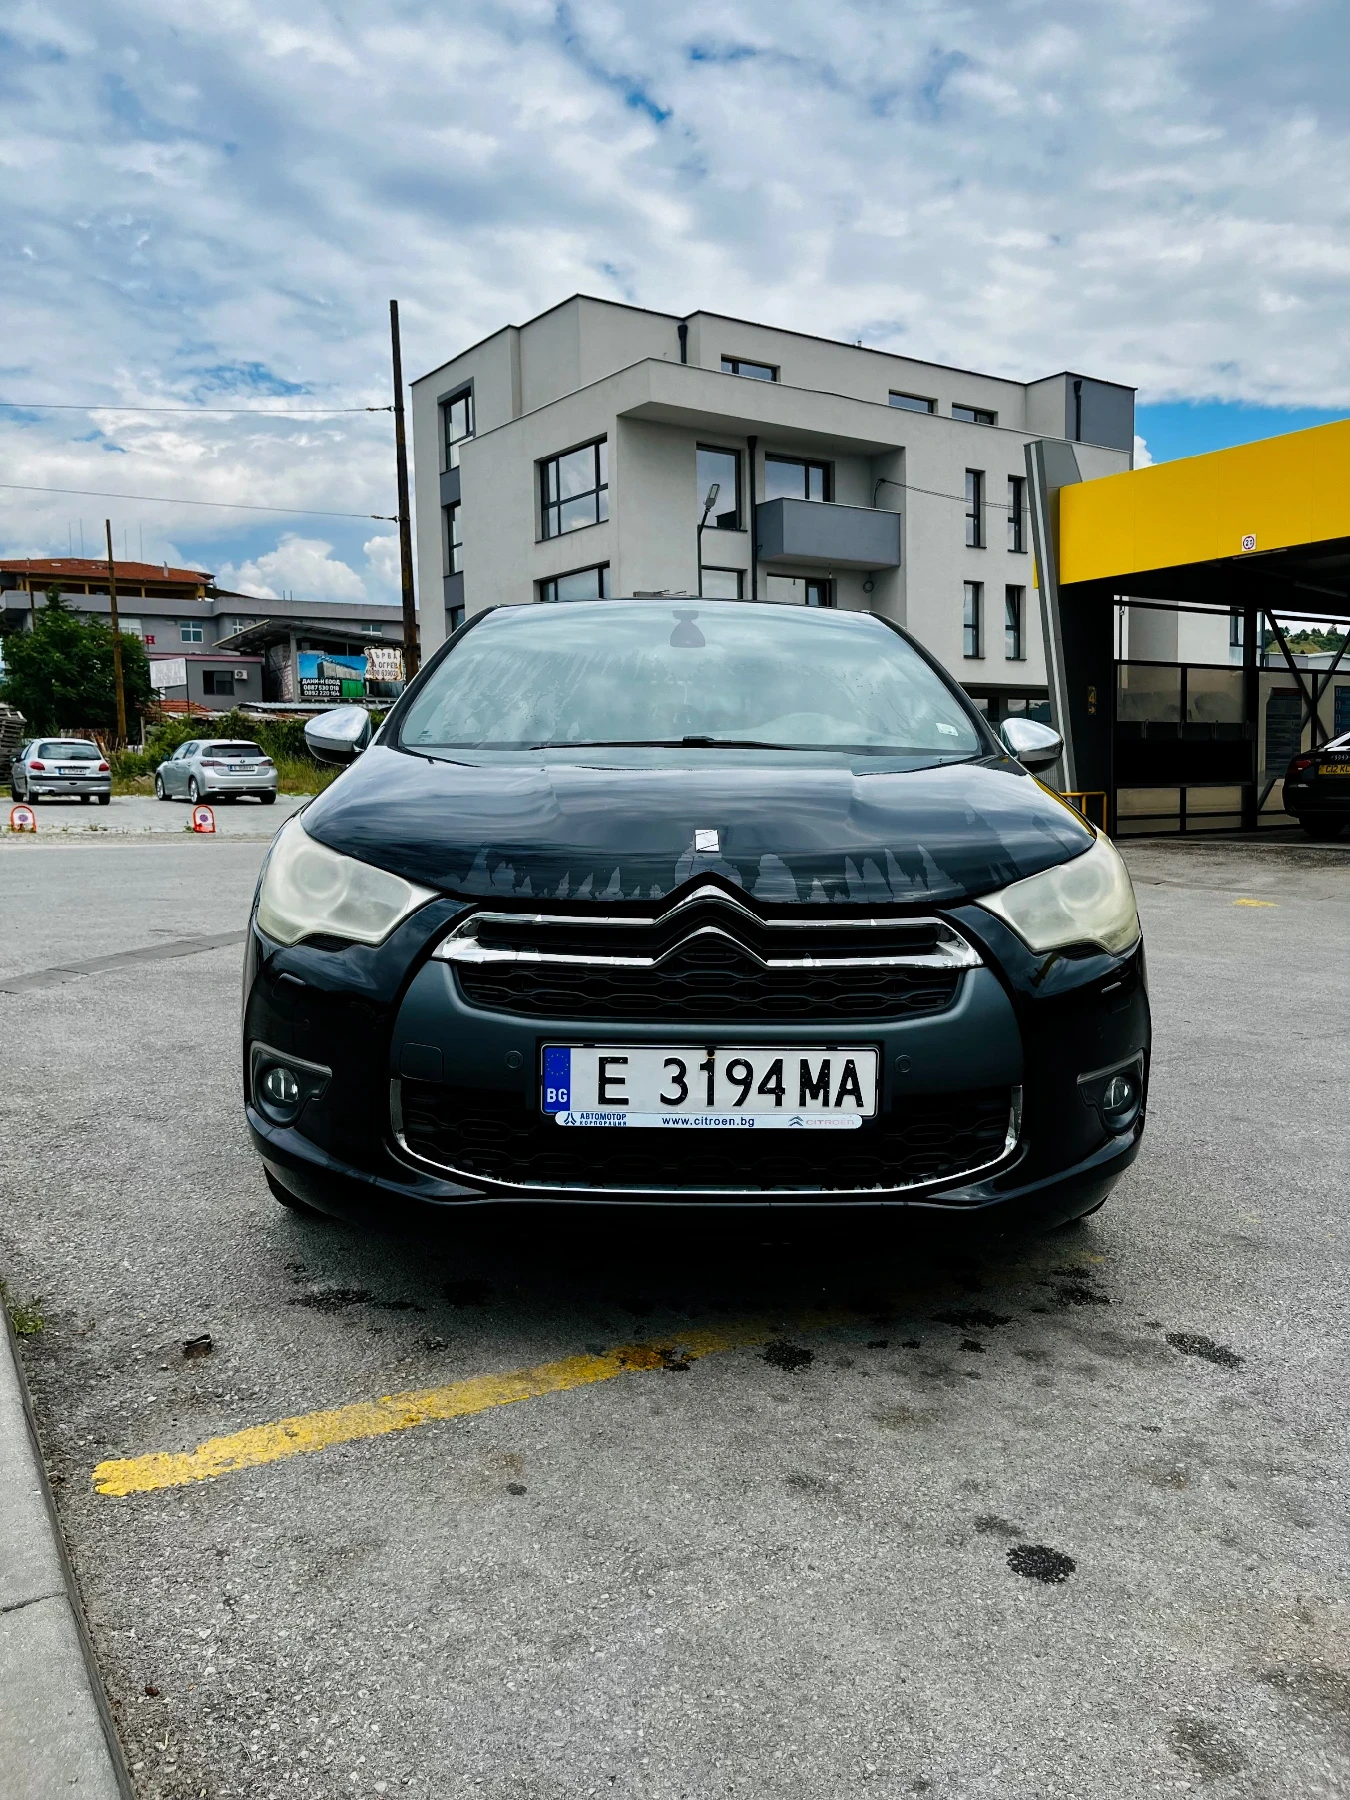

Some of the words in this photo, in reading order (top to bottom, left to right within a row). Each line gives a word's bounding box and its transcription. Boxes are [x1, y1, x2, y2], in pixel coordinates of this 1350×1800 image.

[598, 1055, 629, 1105] E
[547, 1087, 568, 1103] BG
[580, 1112, 627, 1121] АВТОМОТОР
[661, 1116, 756, 1128] www.citroen.bg
